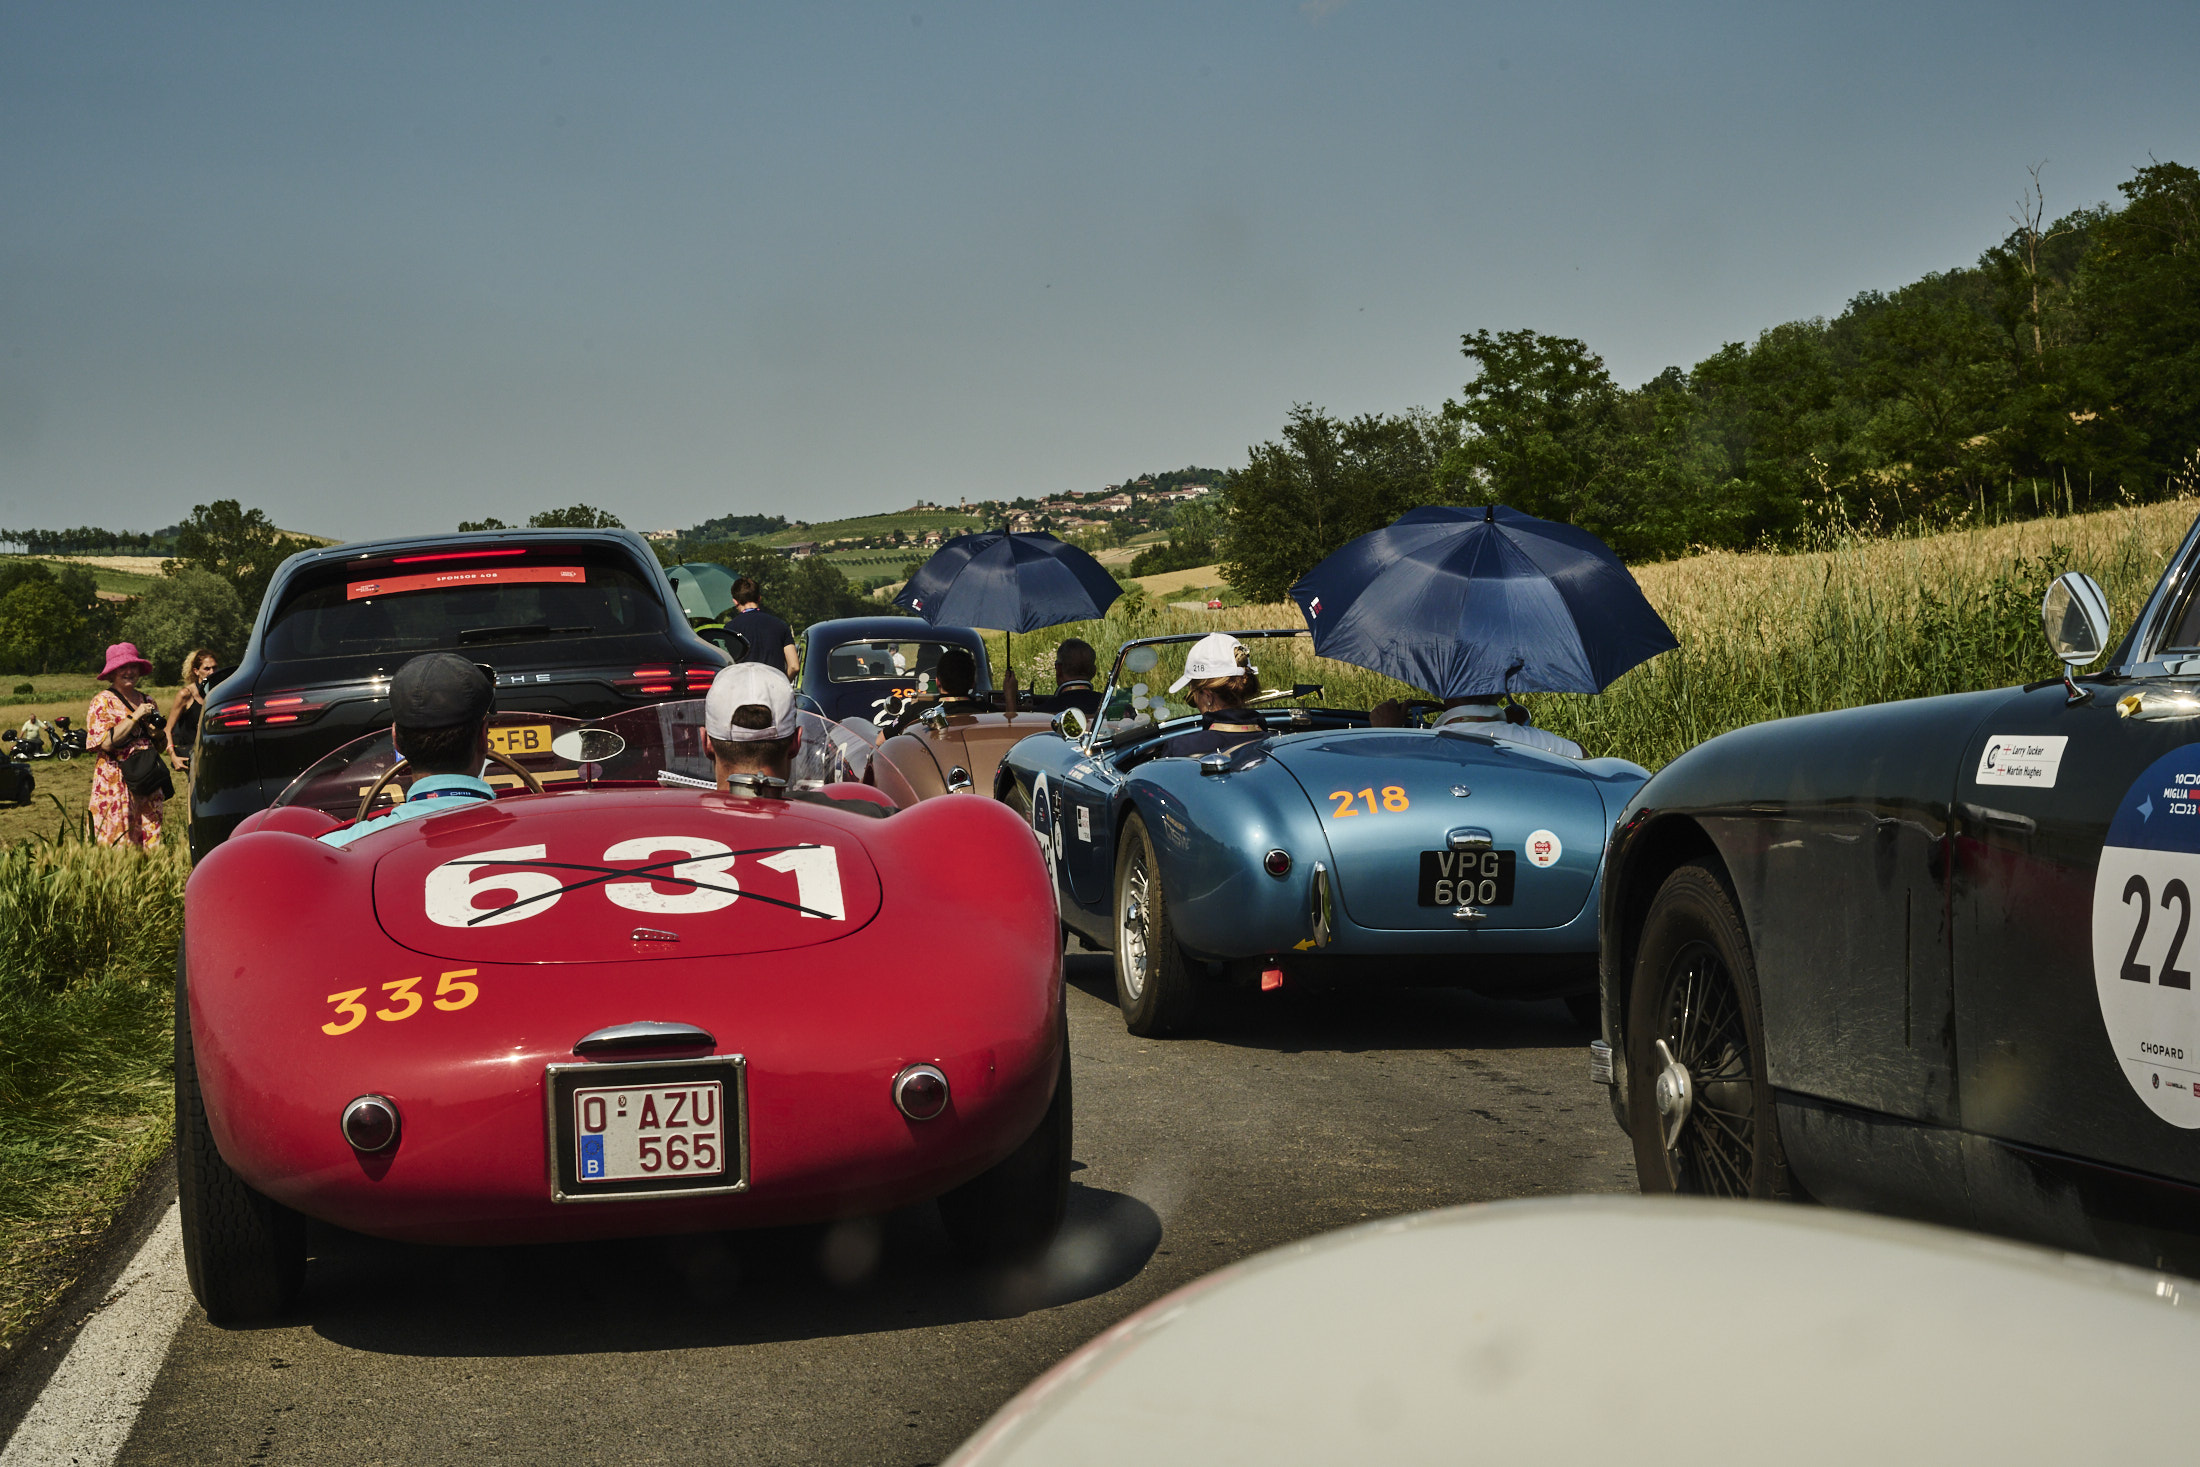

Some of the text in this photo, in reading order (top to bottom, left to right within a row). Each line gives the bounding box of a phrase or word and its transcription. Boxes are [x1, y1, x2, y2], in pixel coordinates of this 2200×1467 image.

[436, 574, 477, 582] SPONSOR
[1193, 664, 1205, 672] 218
[2012, 745, 2044, 758] Larry Tucker
[2006, 765, 2042, 779] Martin Hughes
[1328, 785, 1410, 819] 218
[2163, 787, 2188, 799] MIGLIA
[2169, 802, 2197, 815] 2023
[1437, 851, 1499, 878] VPG
[425, 835, 846, 929] 631
[1434, 879, 1497, 905] 600
[2120, 874, 2191, 990] 22
[321, 968, 479, 1036] 335
[2141, 1041, 2184, 1060] CHOPARD
[639, 1133, 717, 1173] 565
[587, 1160, 599, 1174] B
